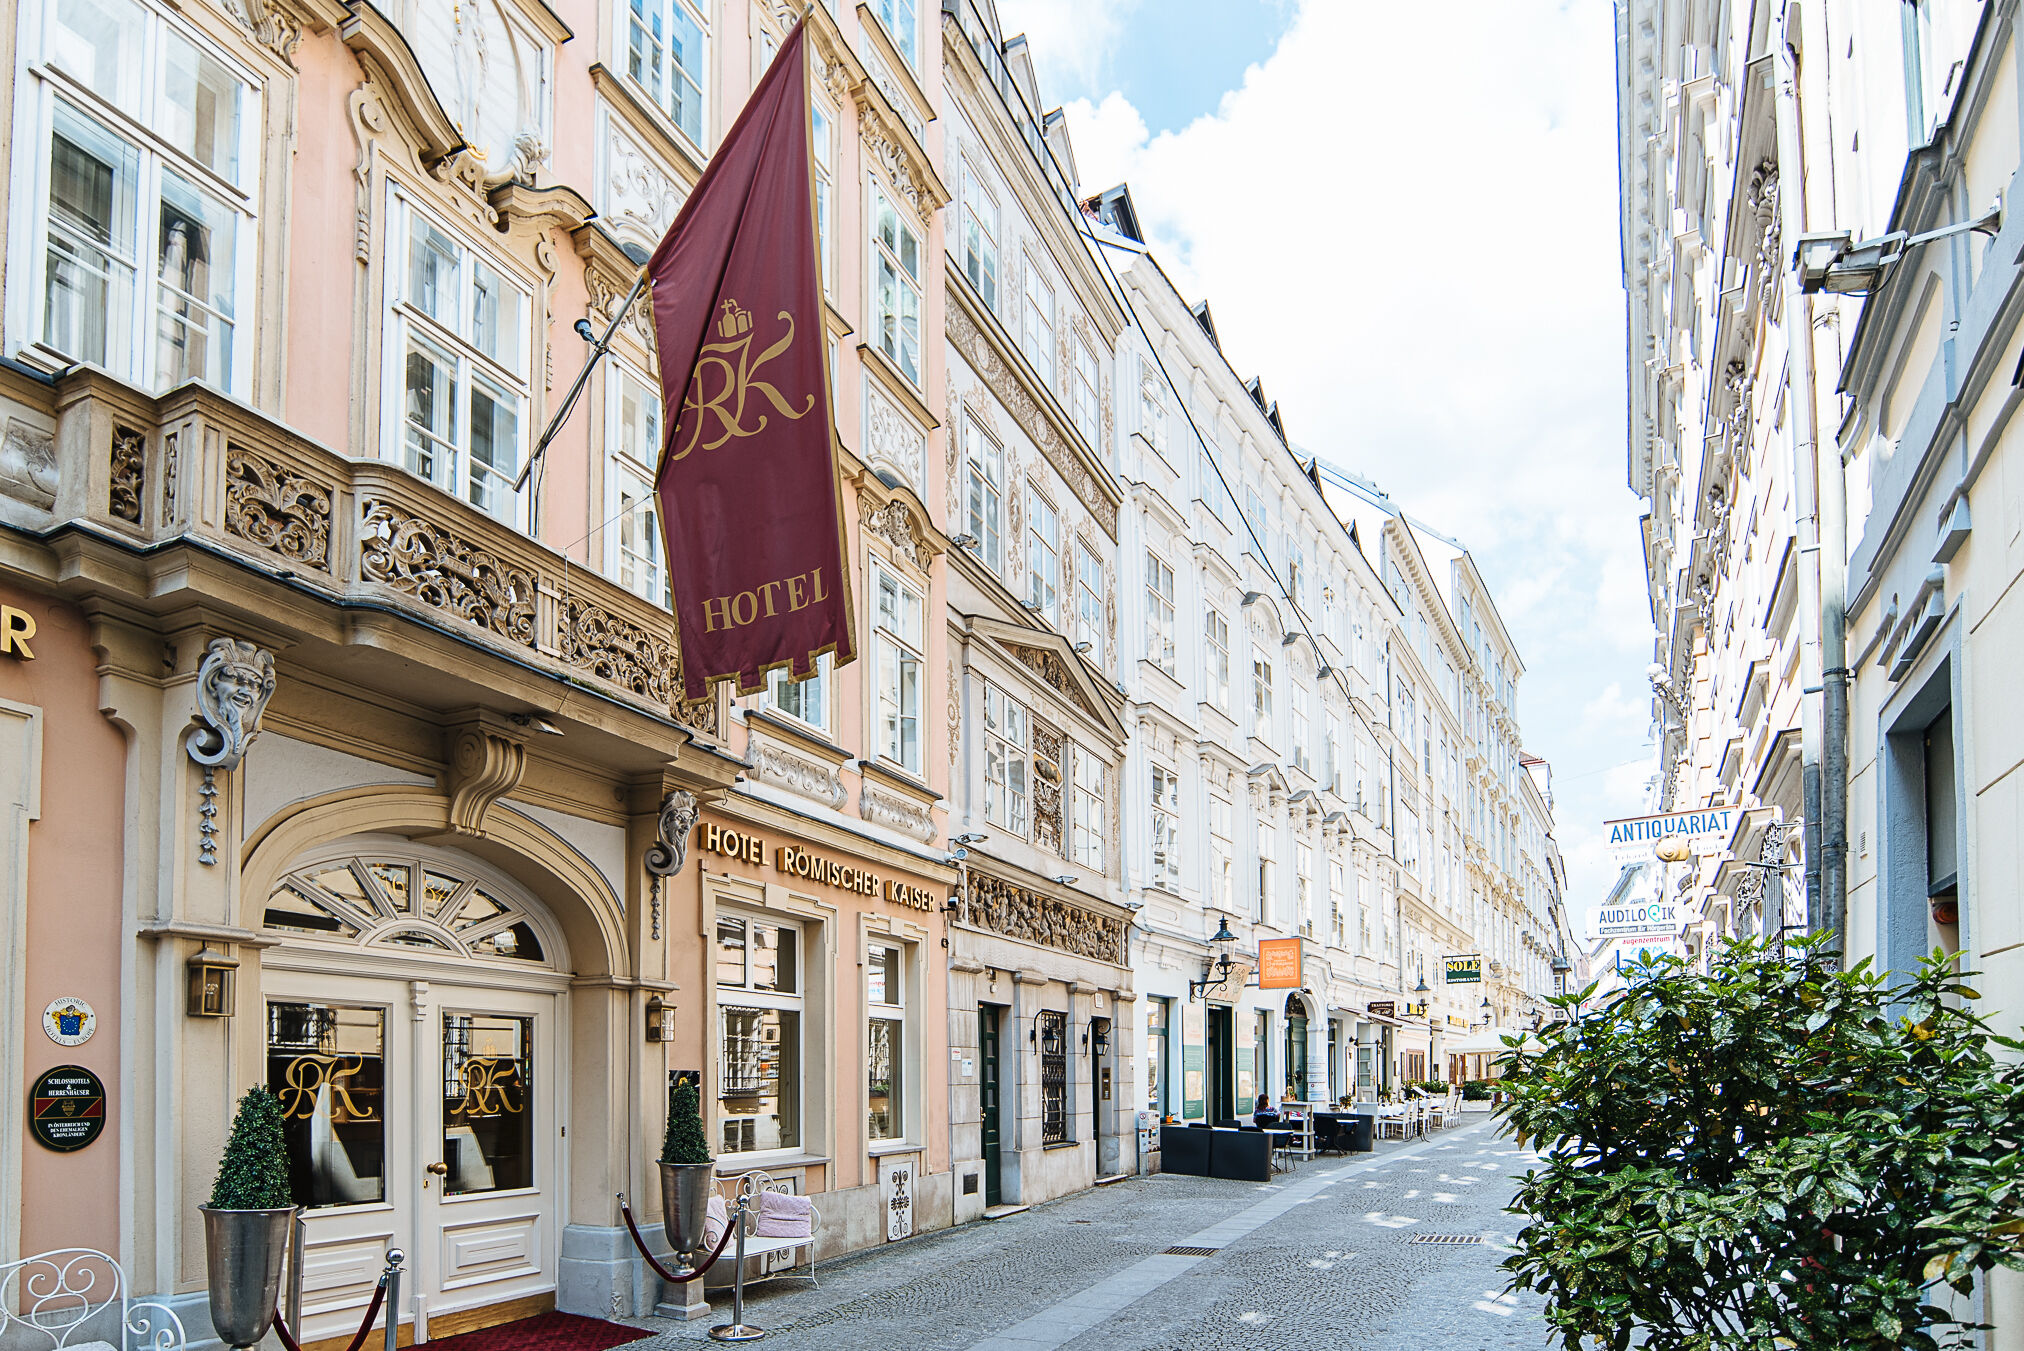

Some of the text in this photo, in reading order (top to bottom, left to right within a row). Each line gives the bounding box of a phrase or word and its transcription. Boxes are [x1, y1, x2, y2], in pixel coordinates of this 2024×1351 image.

[701, 567, 829, 634] HOTEL
[1610, 811, 1731, 844] ANTIQUARIAT
[704, 822, 936, 913] HOTEL RÖMISCHER KAISER
[1622, 936, 1671, 946] augenzentrum
[1447, 960, 1480, 972] SOLE
[54, 998, 85, 1007] HISTORIC
[45, 1025, 95, 1045] HOTELS EUROPE
[48, 1088, 90, 1097] HERRENHÄUSER
